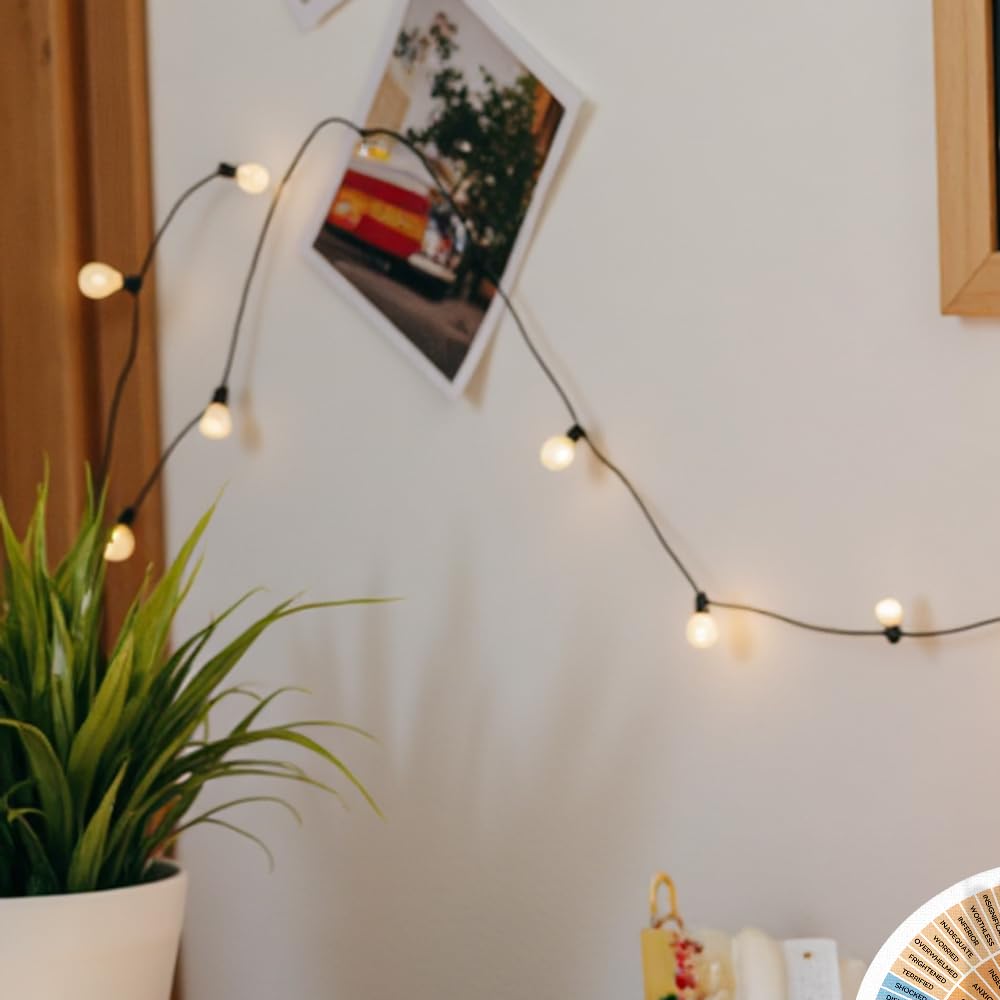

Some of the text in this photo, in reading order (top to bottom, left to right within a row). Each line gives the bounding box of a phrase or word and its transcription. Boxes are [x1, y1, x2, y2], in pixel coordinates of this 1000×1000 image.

[940, 920, 973, 958] INADEQUATE
[958, 916, 979, 946] INFERIOR
[971, 905, 994, 947] WORTHLESS
[914, 938, 958, 979] OVERWHELMED
[933, 935, 959, 962] WORRIED
[902, 968, 934, 990] TERRIFIED
[909, 954, 946, 984] FRIGHTENED
